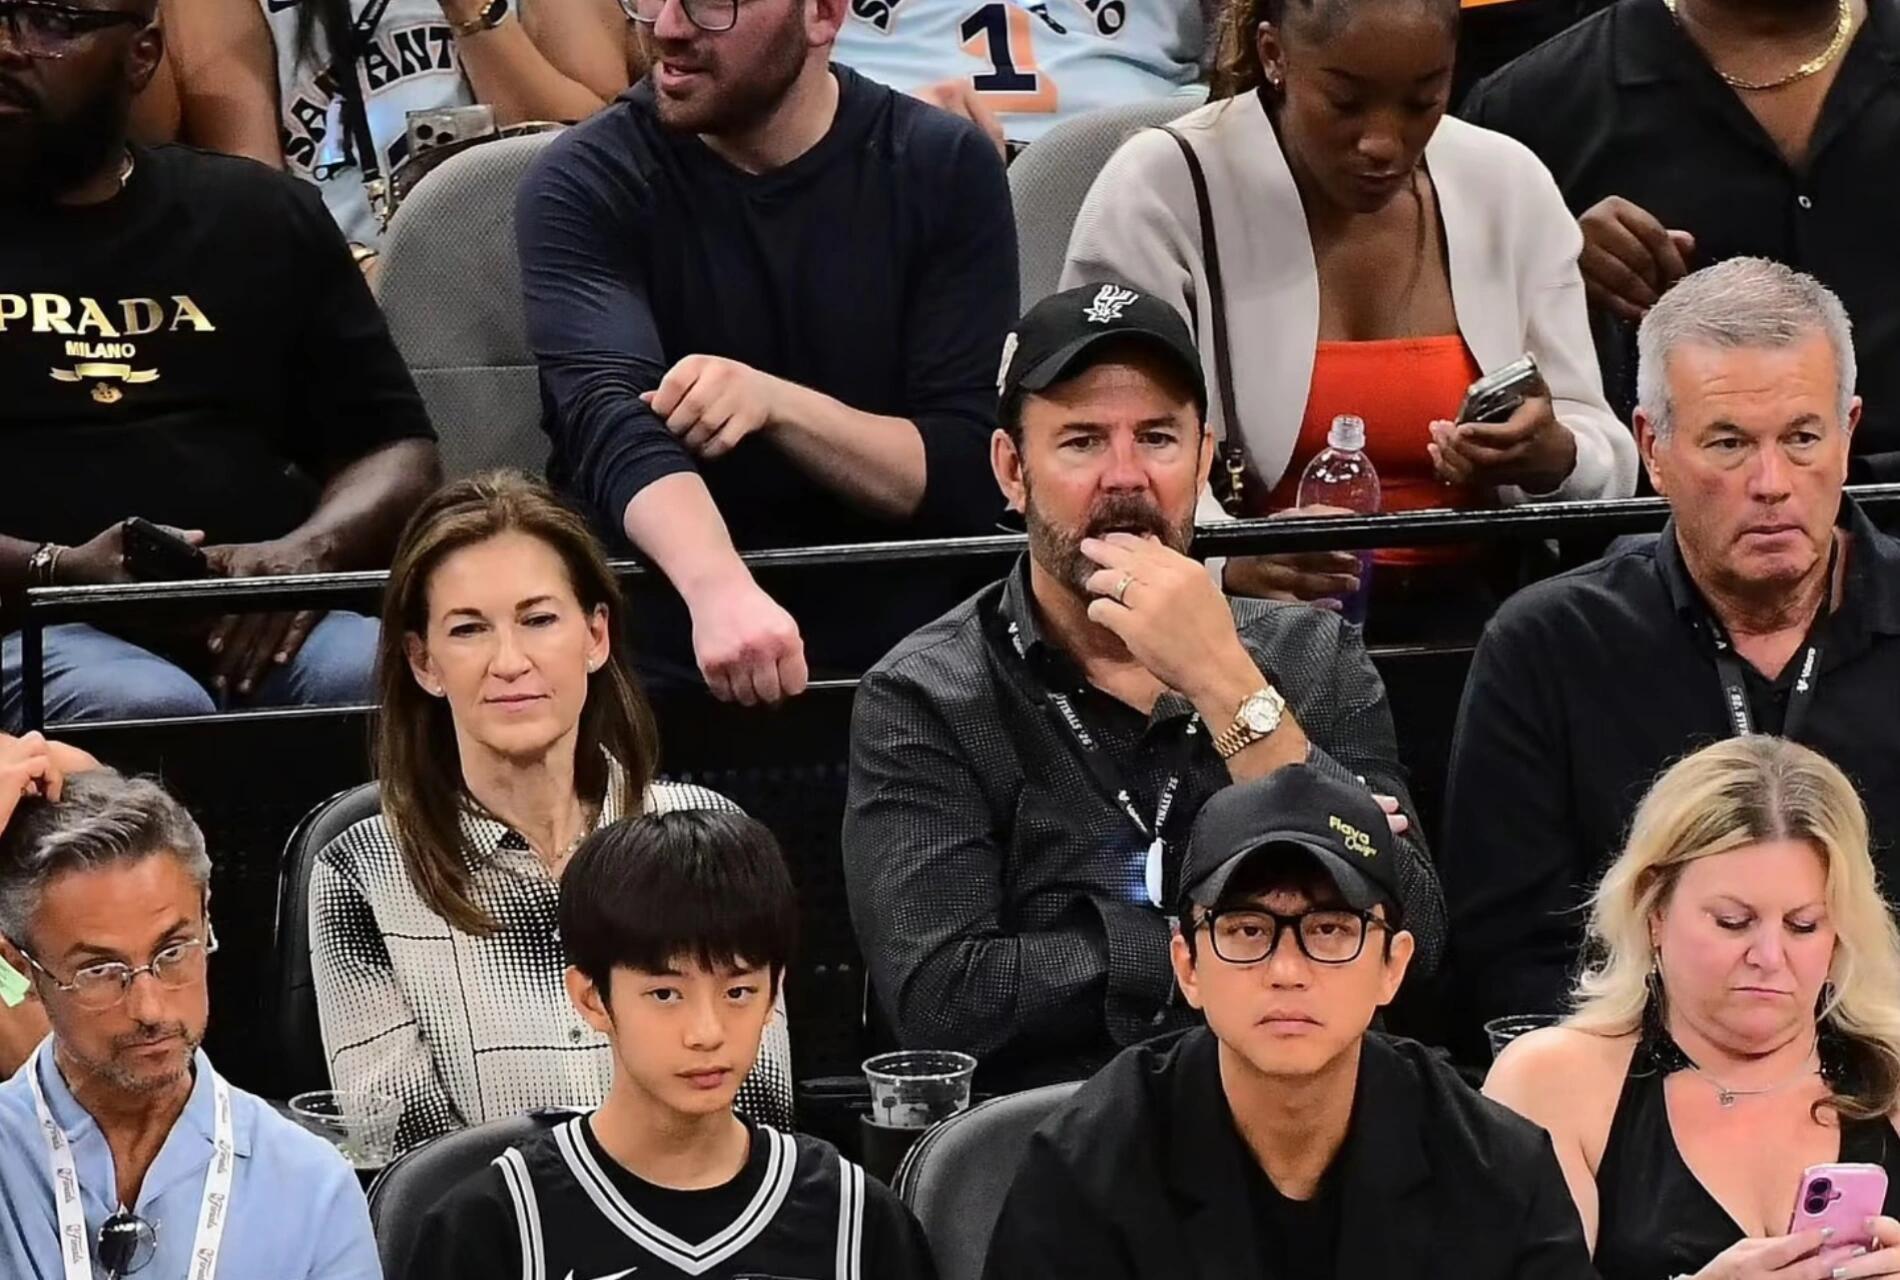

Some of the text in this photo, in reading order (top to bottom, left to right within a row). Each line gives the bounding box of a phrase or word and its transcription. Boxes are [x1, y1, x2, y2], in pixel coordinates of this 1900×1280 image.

[365, 26, 454, 92] ANT
[960, 3, 1037, 92] 1
[0, 293, 216, 337] PRADA
[65, 340, 136, 358] MILANO
[1801, 648, 1816, 678] Valero
[1056, 699, 1082, 731] FINALS
[1155, 793, 1173, 827] FINALS
[207, 1192, 225, 1230] Finals
[66, 1224, 84, 1264] Finals
